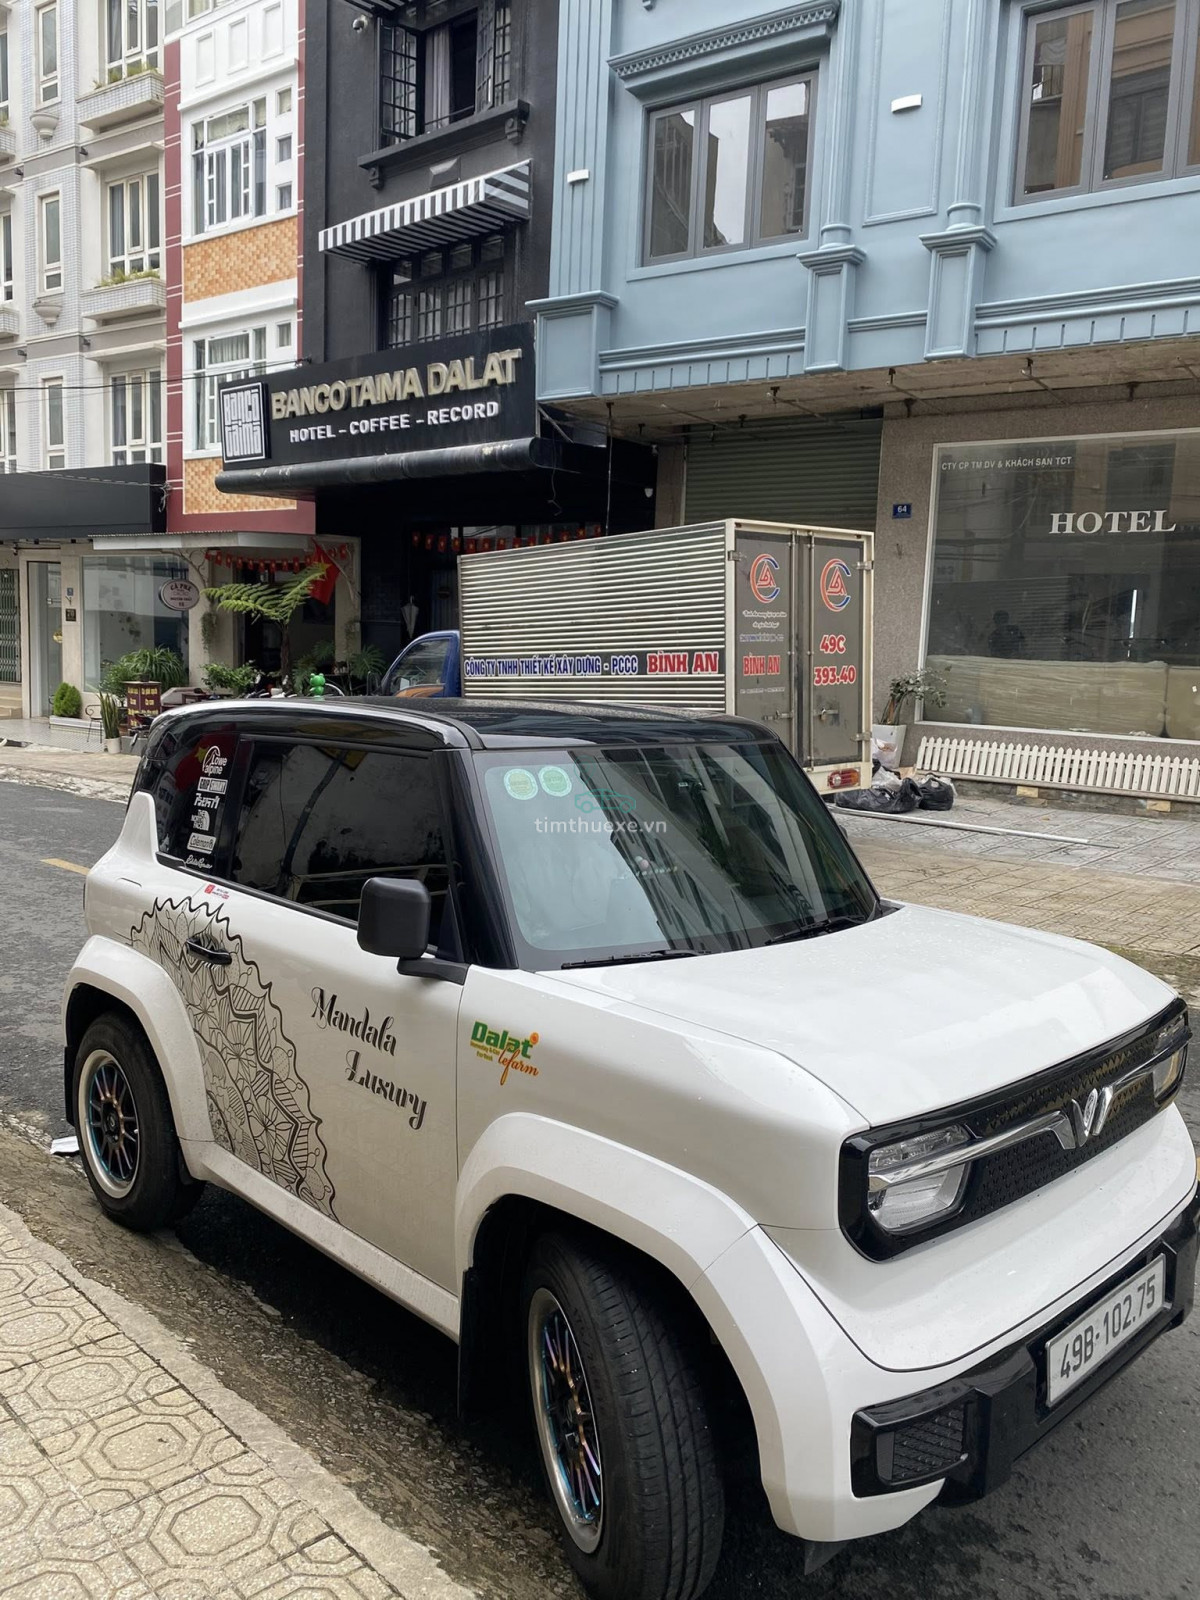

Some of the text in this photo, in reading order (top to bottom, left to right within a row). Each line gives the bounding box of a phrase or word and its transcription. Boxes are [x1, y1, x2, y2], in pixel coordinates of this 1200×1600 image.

[270, 348, 522, 421] BANCOTAIMA DALAT
[289, 424, 336, 443] HOTEL
[349, 413, 411, 436] COFFEE
[427, 402, 500, 425] RECORD
[941, 462, 956, 471] CTY
[958, 462, 969, 470] CP
[971, 462, 983, 470] TM
[1005, 457, 1034, 468] KHÁCH
[1035, 457, 1053, 469] SẠN
[1055, 456, 1073, 466] TCT
[897, 505, 908, 514] 64
[1049, 510, 1177, 534] HOTEL
[820, 635, 847, 654] 49C
[464, 657, 485, 676] CÔNG
[497, 660, 518, 676] TNHH
[520, 655, 542, 675] THIẾT
[543, 655, 555, 675] KẾ
[556, 655, 573, 675] XÂY
[575, 655, 601, 677] DỰNG
[611, 655, 638, 675] PCCC
[647, 650, 688, 674] BÌNH
[692, 651, 719, 674] AN
[743, 653, 780, 676] BÌNH AN
[813, 664, 857, 686] 393.40
[310, 986, 397, 1056] Mandala
[471, 1021, 534, 1059] Dalat
[344, 1049, 427, 1130] Luxury
[1060, 1274, 1156, 1379] 49B-102.75
